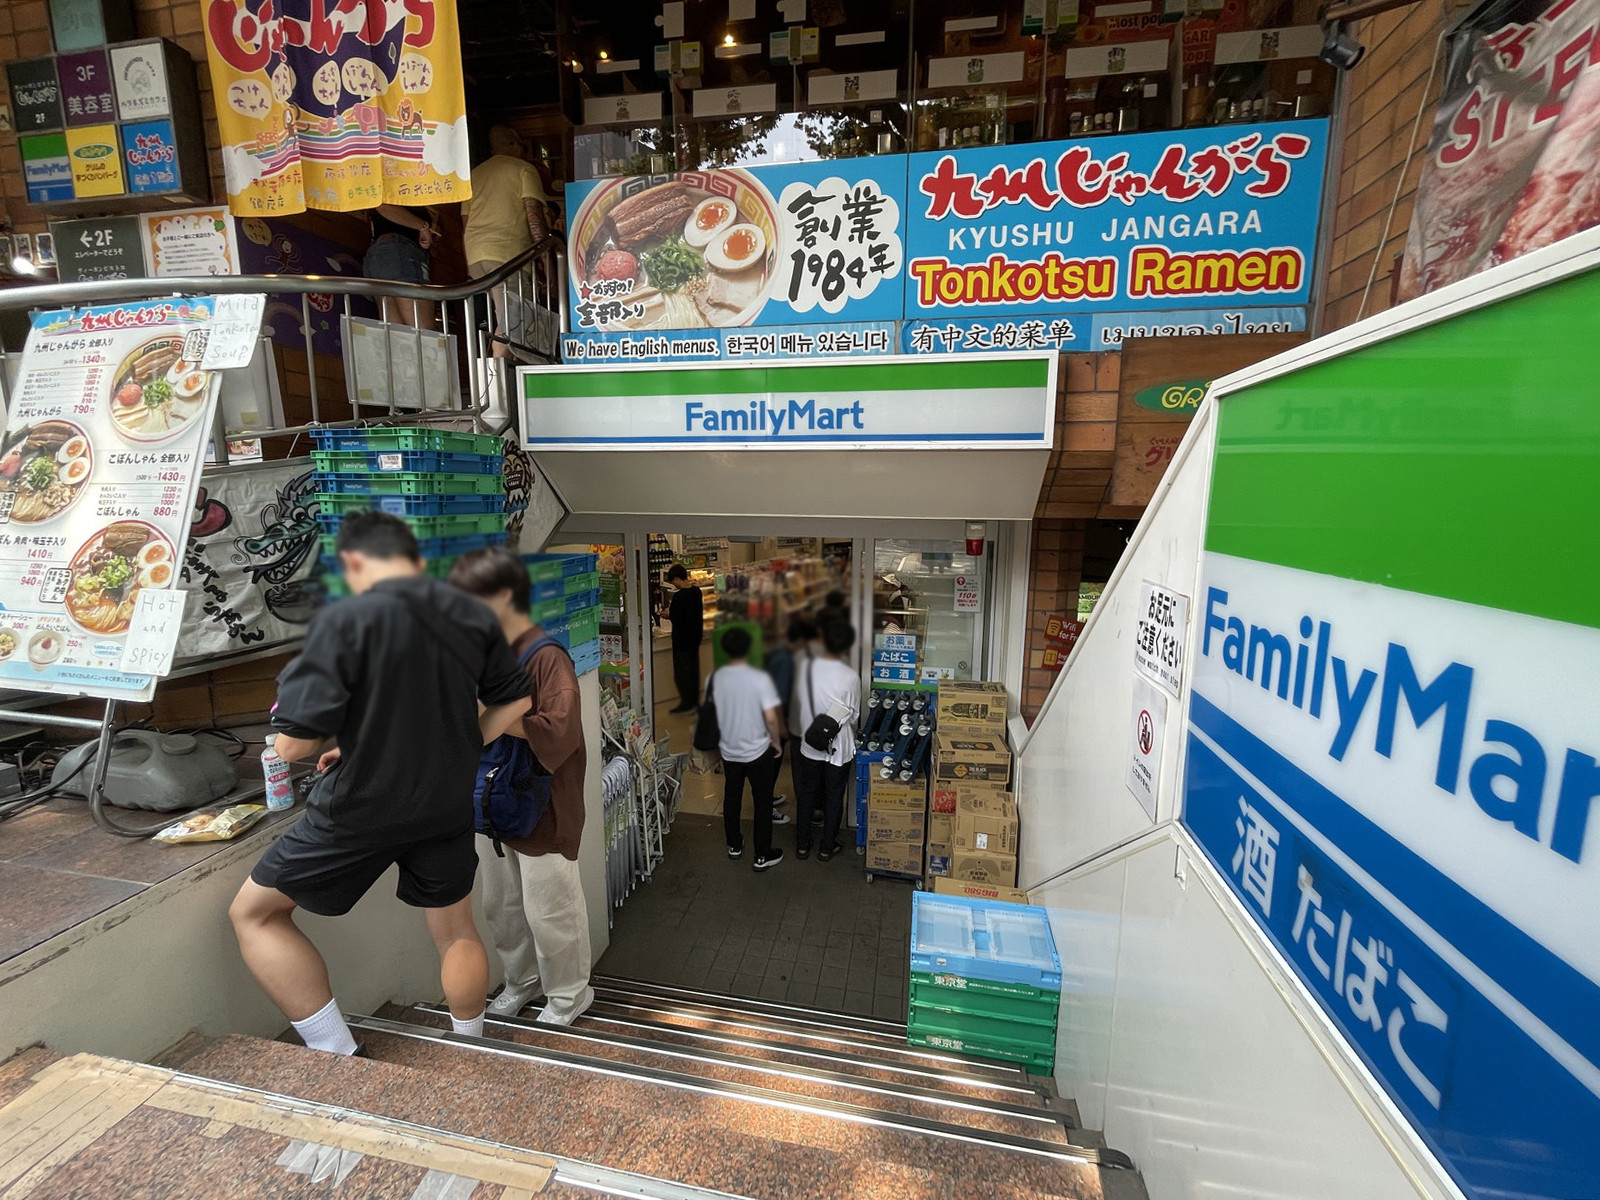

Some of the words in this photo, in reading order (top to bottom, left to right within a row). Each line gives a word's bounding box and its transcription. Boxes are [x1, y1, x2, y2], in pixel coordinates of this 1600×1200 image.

[76, 64, 95, 81] 3F
[68, 92, 113, 116] 美容室
[921, 132, 1310, 219] 九州じゃんがら
[787, 186, 887, 249] 創業
[95, 229, 113, 246] 2F
[949, 221, 1074, 251] KYUSHU
[1101, 209, 1262, 243] JANGARA
[788, 243, 895, 302] 1984年
[914, 256, 1115, 303] Tonkotsu
[1133, 250, 1298, 294] Ramen
[218, 297, 259, 312] Mild
[727, 334, 775, 355] 한국어
[781, 333, 813, 353] 메뉴
[818, 331, 887, 351] 있습니다
[912, 319, 1076, 353] 有中文的菜单
[566, 340, 587, 357] We
[589, 341, 619, 357] have
[622, 339, 670, 357] English
[686, 400, 865, 435] FamilyMart
[109, 453, 157, 464] こぼんしゃん
[160, 453, 190, 463] 全部入り
[96, 506, 140, 516] こぼんしゃん
[141, 594, 179, 613] Hot
[143, 621, 166, 632] and
[1062, 620, 1077, 632] Wifi
[880, 651, 909, 663] たばこ
[1232, 795, 1280, 919] 酒
[1291, 863, 1449, 1111] たばこ
[934, 975, 968, 989] 東京堂
[930, 1037, 963, 1050] 東京堂
